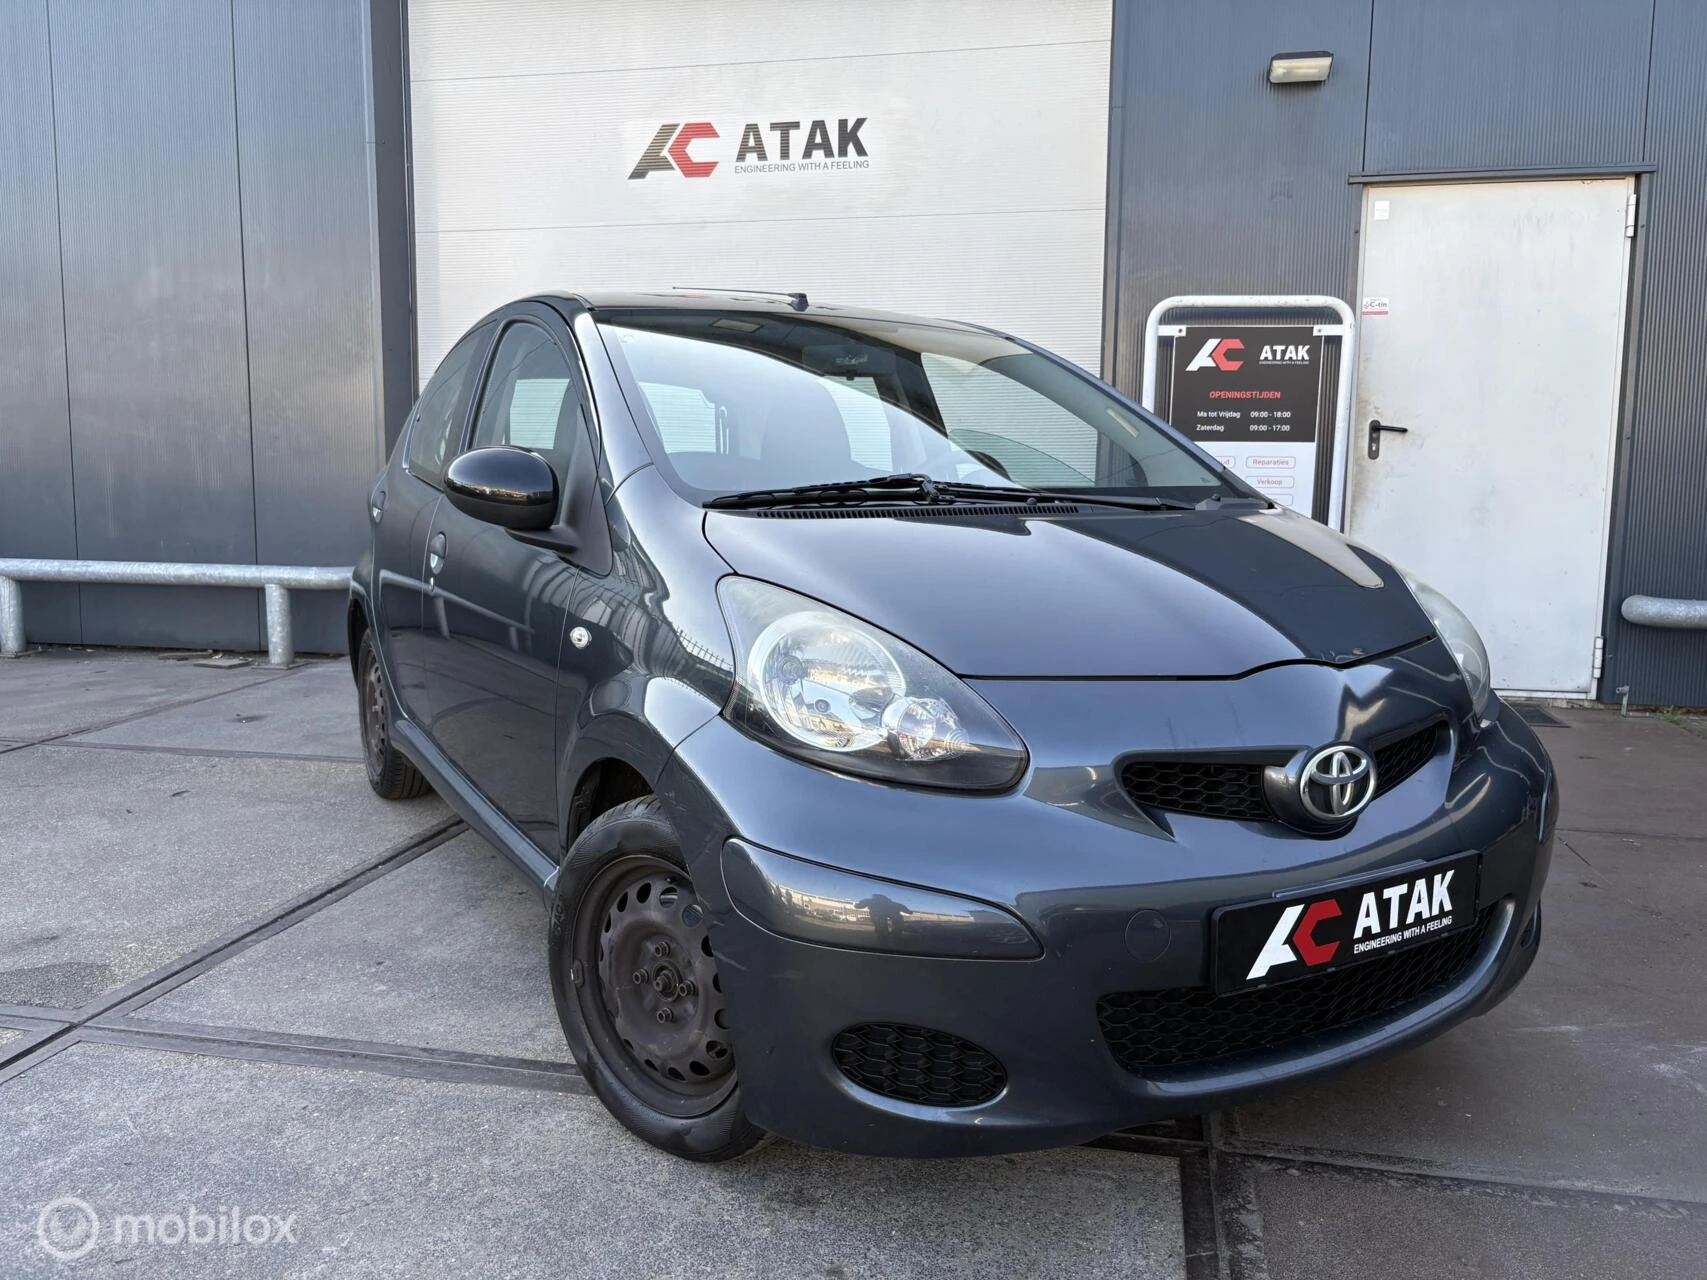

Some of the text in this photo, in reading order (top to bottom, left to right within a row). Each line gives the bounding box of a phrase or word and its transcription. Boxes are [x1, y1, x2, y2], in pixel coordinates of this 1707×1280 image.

[735, 117, 869, 163] ATAK
[734, 160, 870, 174] ENGINEERING WITH A FEELING
[1259, 345, 1311, 361] ATAK
[1208, 391, 1282, 399] OPENINGSTIJDEN
[1218, 411, 1241, 419] Vrijdag
[1196, 424, 1225, 432] Zaterdag
[1249, 424, 1268, 432] 09:00
[1272, 424, 1291, 432] 17:00
[1252, 458, 1290, 468] Reparaties
[1257, 478, 1283, 487] Verkoop
[1353, 869, 1455, 939] ATAK
[1353, 915, 1453, 955] ENGINEERING WITH A FEELING
